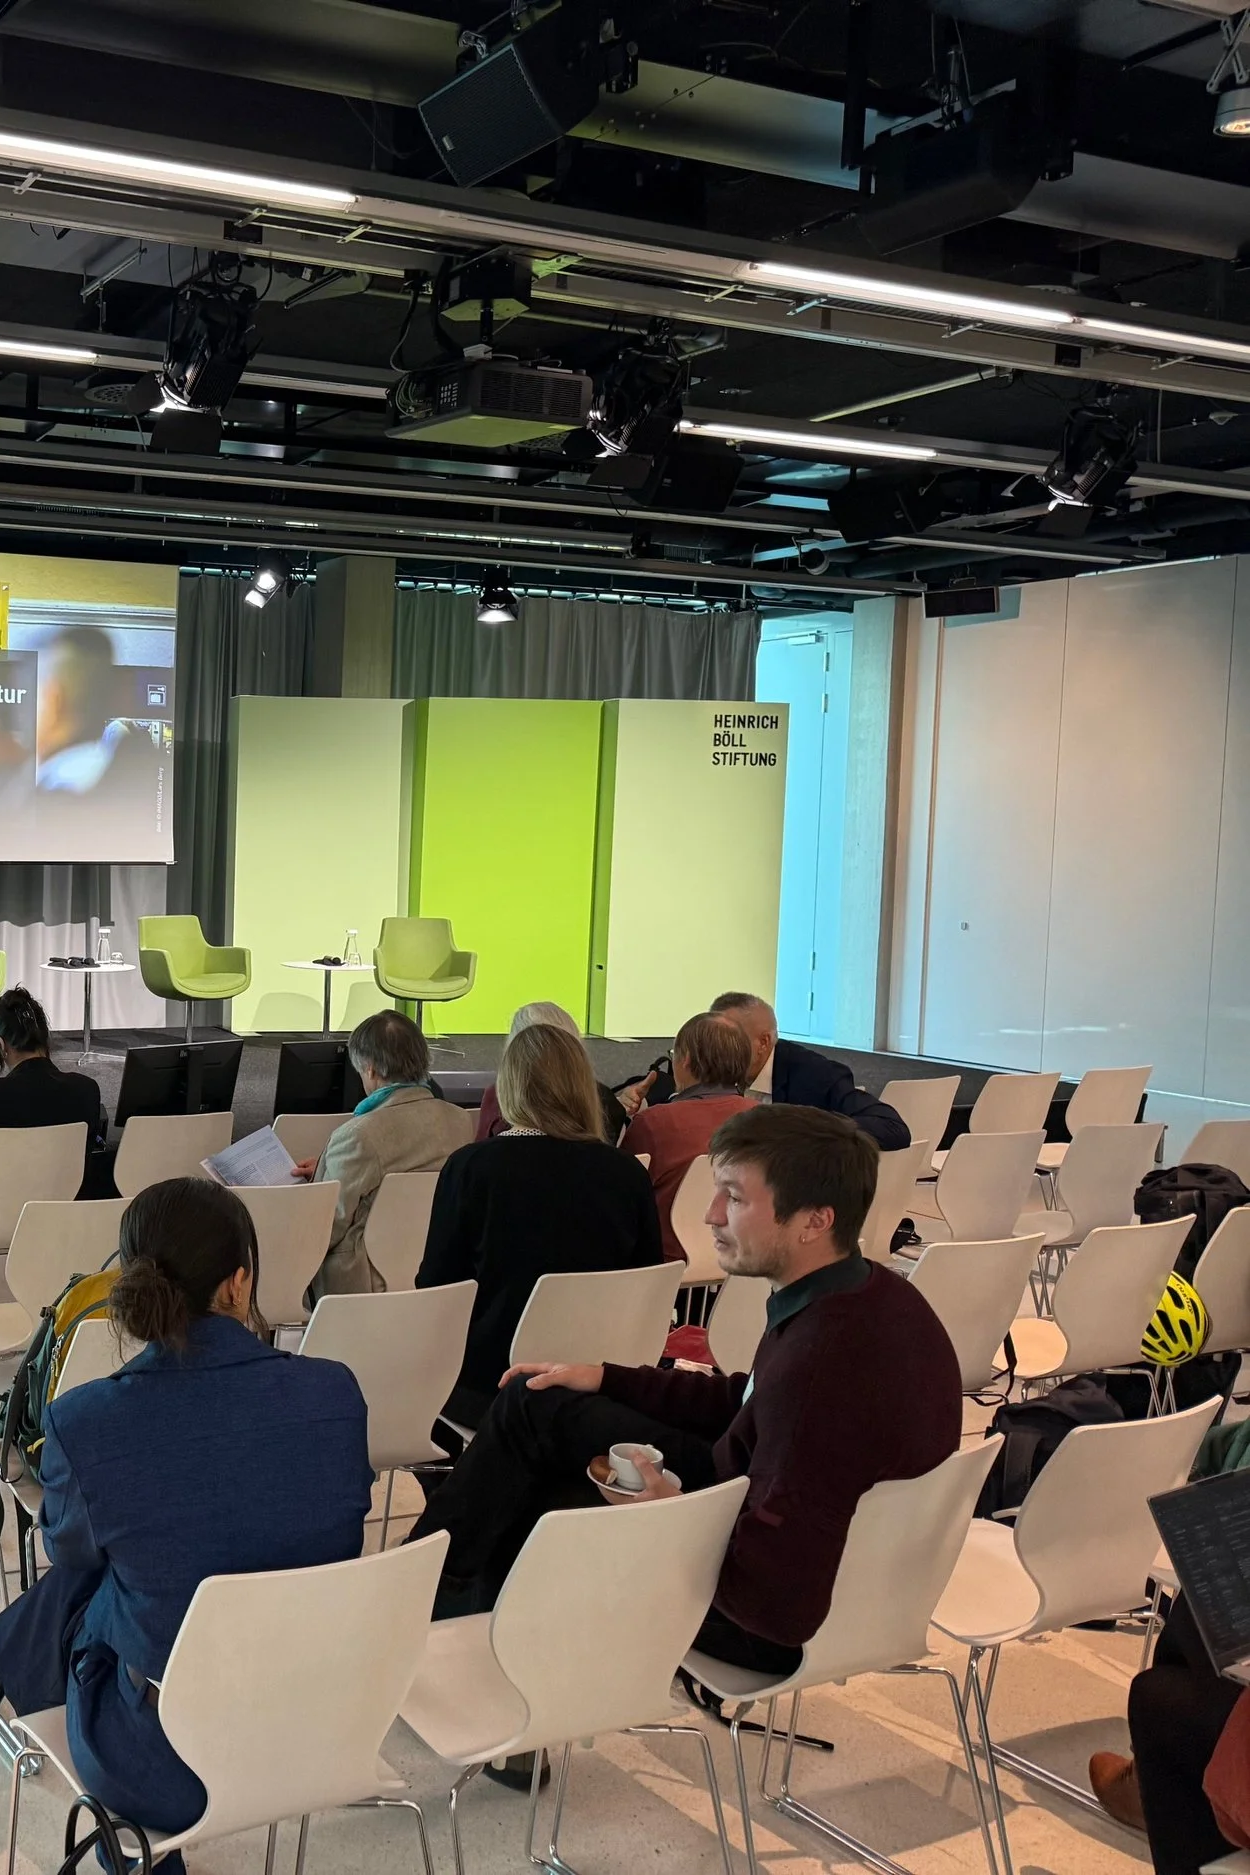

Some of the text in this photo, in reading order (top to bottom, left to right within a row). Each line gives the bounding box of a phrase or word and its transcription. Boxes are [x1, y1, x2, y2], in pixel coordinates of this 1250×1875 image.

[714, 714, 779, 729] HEINRICH
[713, 730, 747, 747] BÖLL
[712, 751, 777, 766] STIFTUNG
